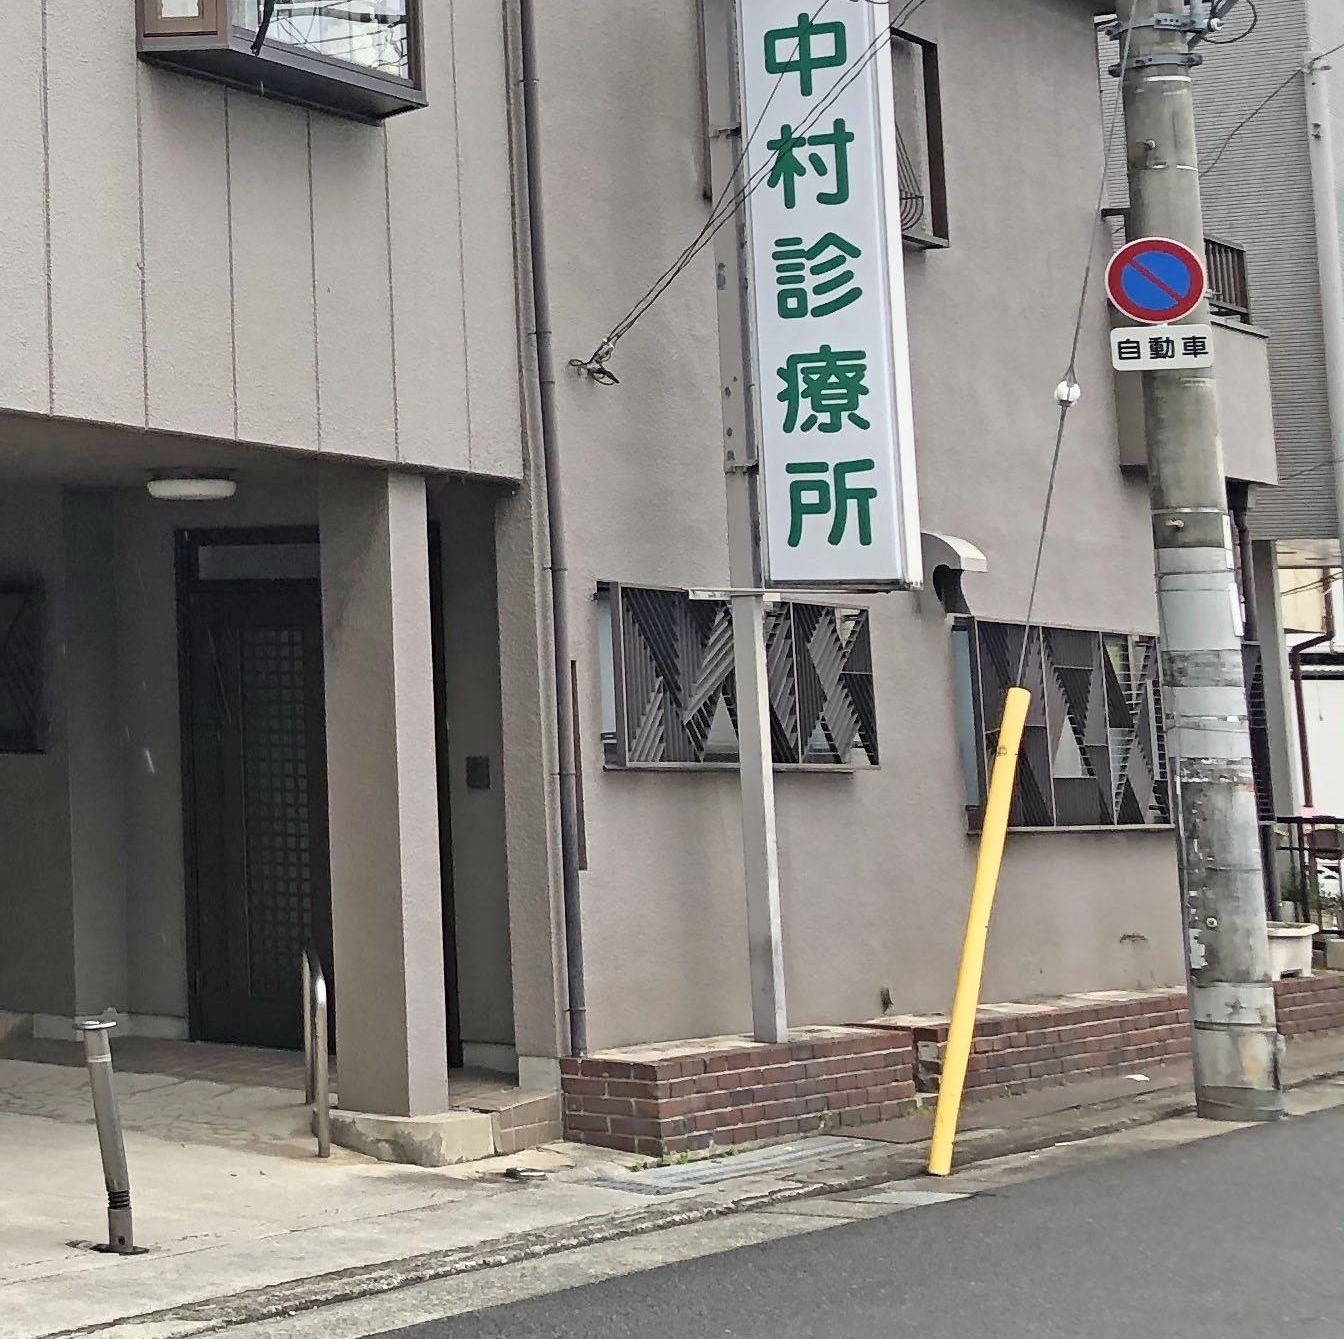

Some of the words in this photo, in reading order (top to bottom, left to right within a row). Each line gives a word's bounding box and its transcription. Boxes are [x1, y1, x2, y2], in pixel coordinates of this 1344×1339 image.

[764, 12, 878, 549] 中村診療所
[1117, 335, 1209, 361] 自動車
